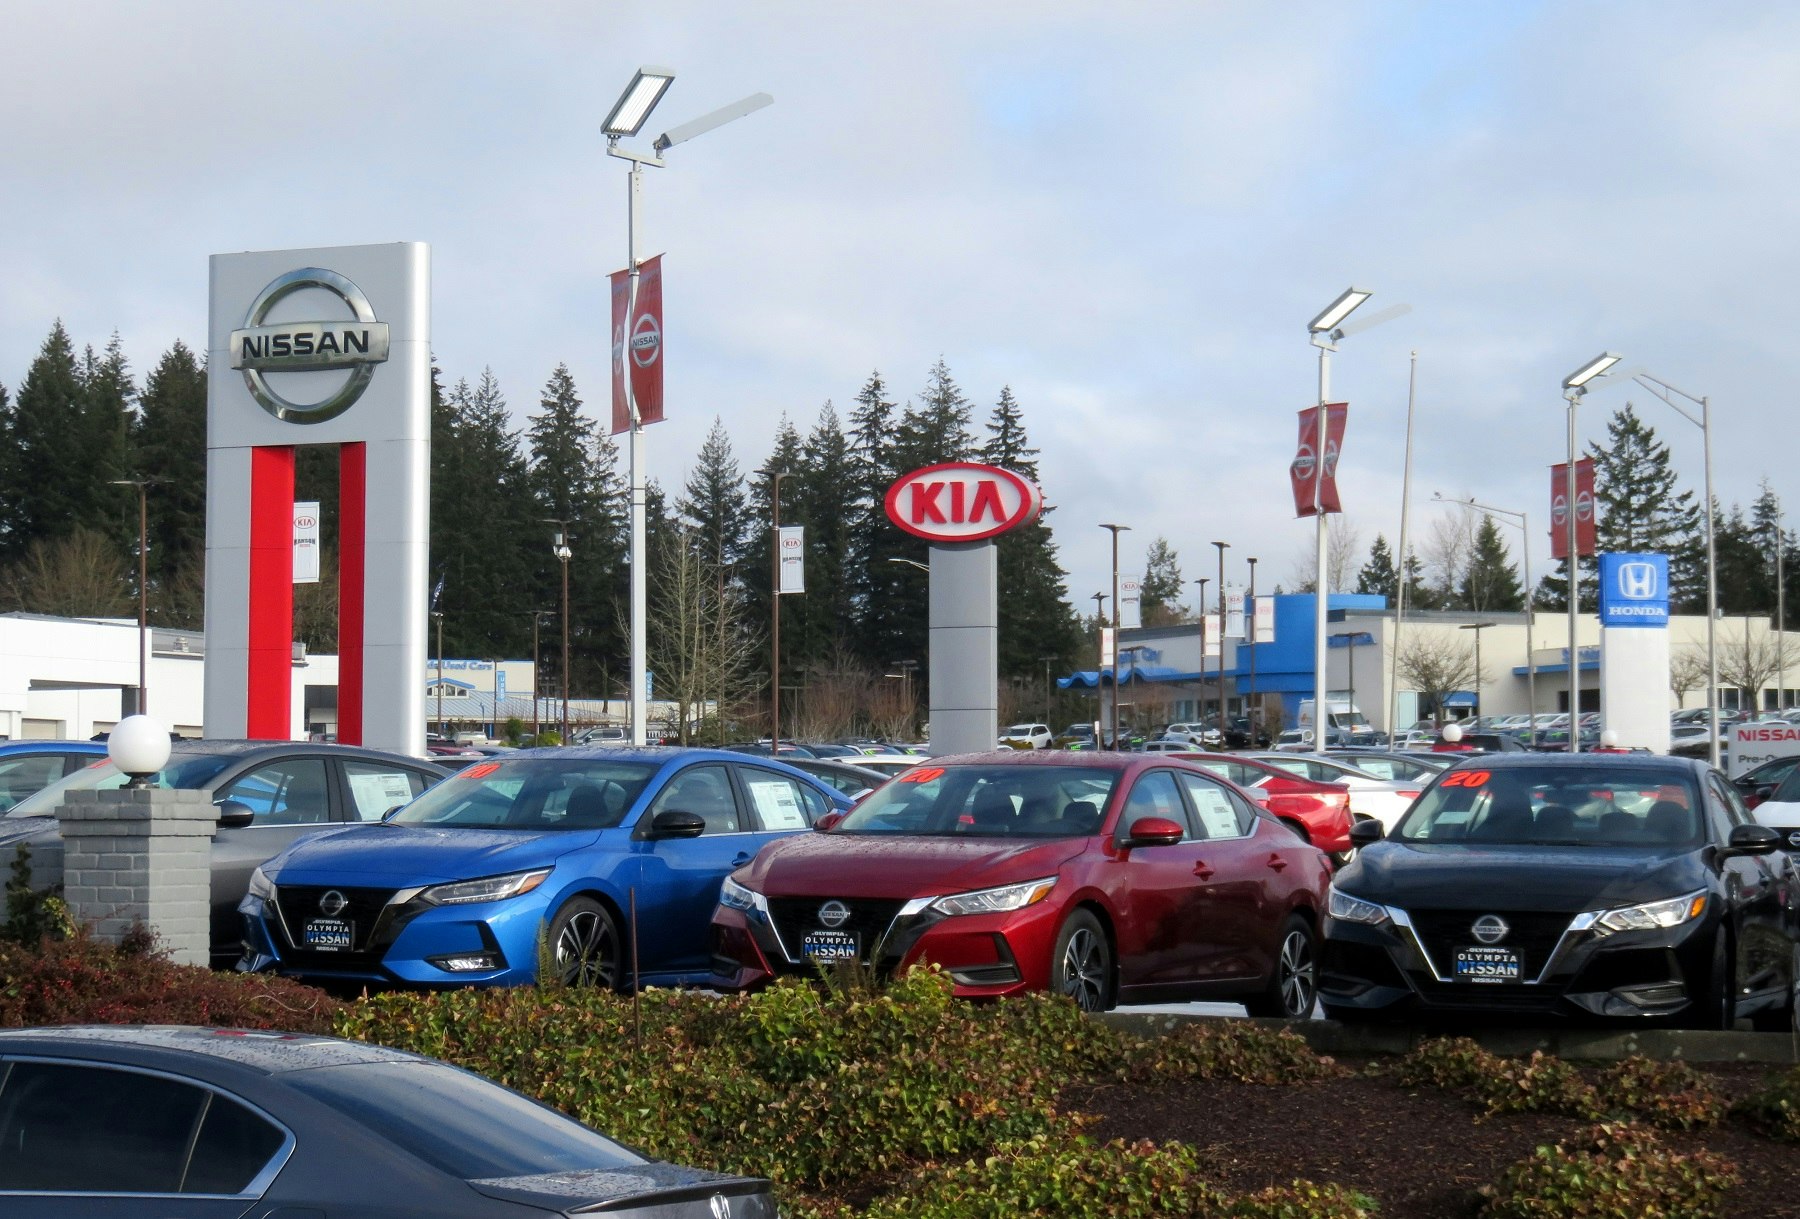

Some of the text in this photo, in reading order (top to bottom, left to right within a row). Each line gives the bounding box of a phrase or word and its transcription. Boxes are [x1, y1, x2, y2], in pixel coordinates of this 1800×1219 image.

[242, 330, 369, 360] NISSAN
[632, 335, 659, 347] NISSAN
[910, 480, 1007, 524] KIA
[1608, 606, 1665, 616] HONDA
[469, 661, 494, 670] Cars
[1737, 728, 1800, 741] NISSA
[899, 767, 945, 783] 20
[1440, 770, 1490, 787] 20
[307, 924, 350, 933] OLYMPIA
[306, 931, 350, 944] NISSAN
[804, 936, 855, 945] OLYMPIA
[804, 943, 855, 957] NISSAN
[1457, 953, 1518, 962] OLYMPIA
[1457, 961, 1519, 975] NISSAN
